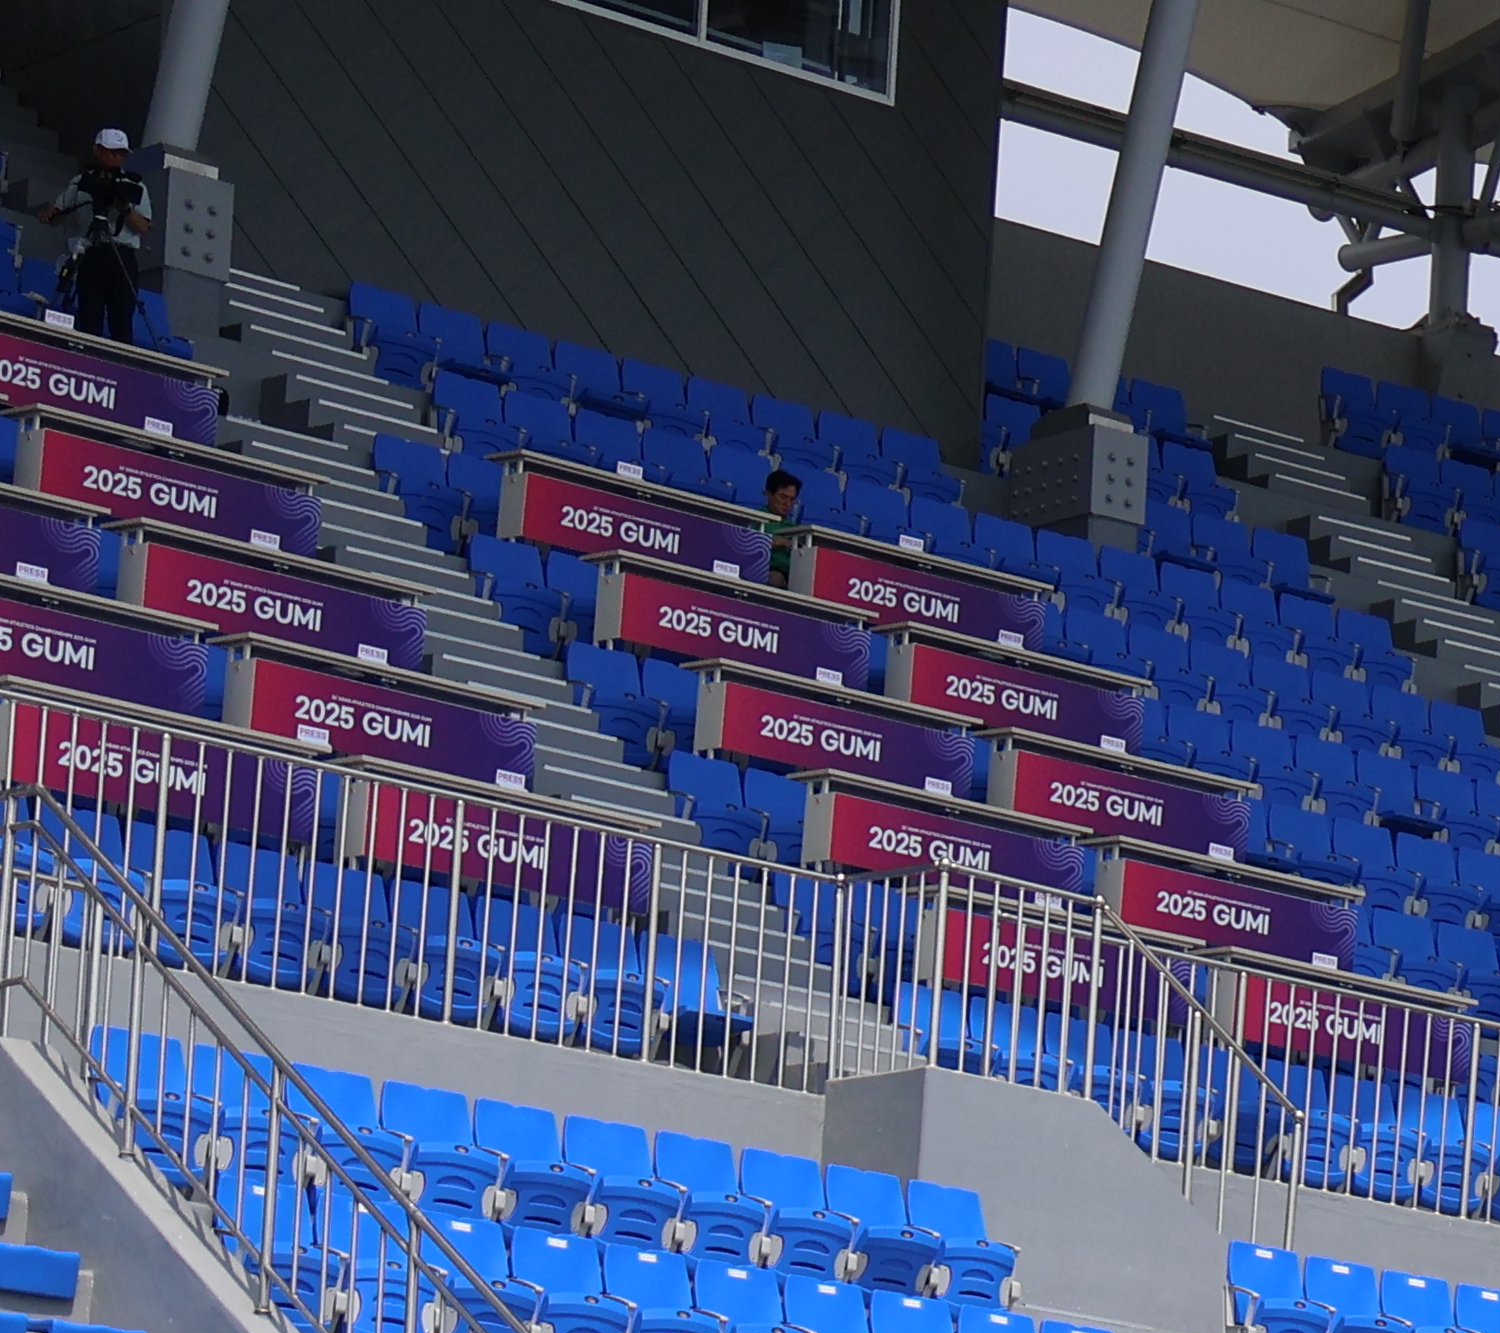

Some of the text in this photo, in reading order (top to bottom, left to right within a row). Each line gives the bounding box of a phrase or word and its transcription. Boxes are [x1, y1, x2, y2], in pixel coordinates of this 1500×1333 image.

[0, 360, 41, 389] 025
[49, 373, 116, 410] GUMI
[83, 466, 142, 499] 2025
[150, 483, 217, 518] GUMI
[561, 506, 613, 536] 2025
[619, 521, 680, 554] GUMI
[19, 566, 46, 579] PRESS
[187, 580, 321, 632] 2025 GUMI
[848, 578, 897, 608] 2025
[903, 592, 959, 623] GUMI
[21, 633, 95, 670] GUMI
[659, 606, 712, 637] 2025
[718, 621, 779, 653] GUMI
[945, 676, 995, 705] 2025
[1001, 690, 1058, 720] GUMI
[295, 695, 431, 748] 2025 GUMI
[300, 729, 327, 741] PRESS
[760, 715, 813, 746] 2025
[820, 730, 882, 762] GUMI
[58, 741, 124, 777] 2025
[134, 758, 206, 796] GUMI
[1050, 782, 1100, 811] 2025
[1106, 796, 1162, 827] GUMI
[477, 835, 545, 870] GUMI
[869, 826, 922, 858] 2025
[929, 842, 991, 873] GUMI
[1156, 891, 1206, 920] 2025
[1213, 904, 1270, 935] GUMI
[1270, 1002, 1319, 1031] 2025
[1325, 1016, 1381, 1045] GUMI
